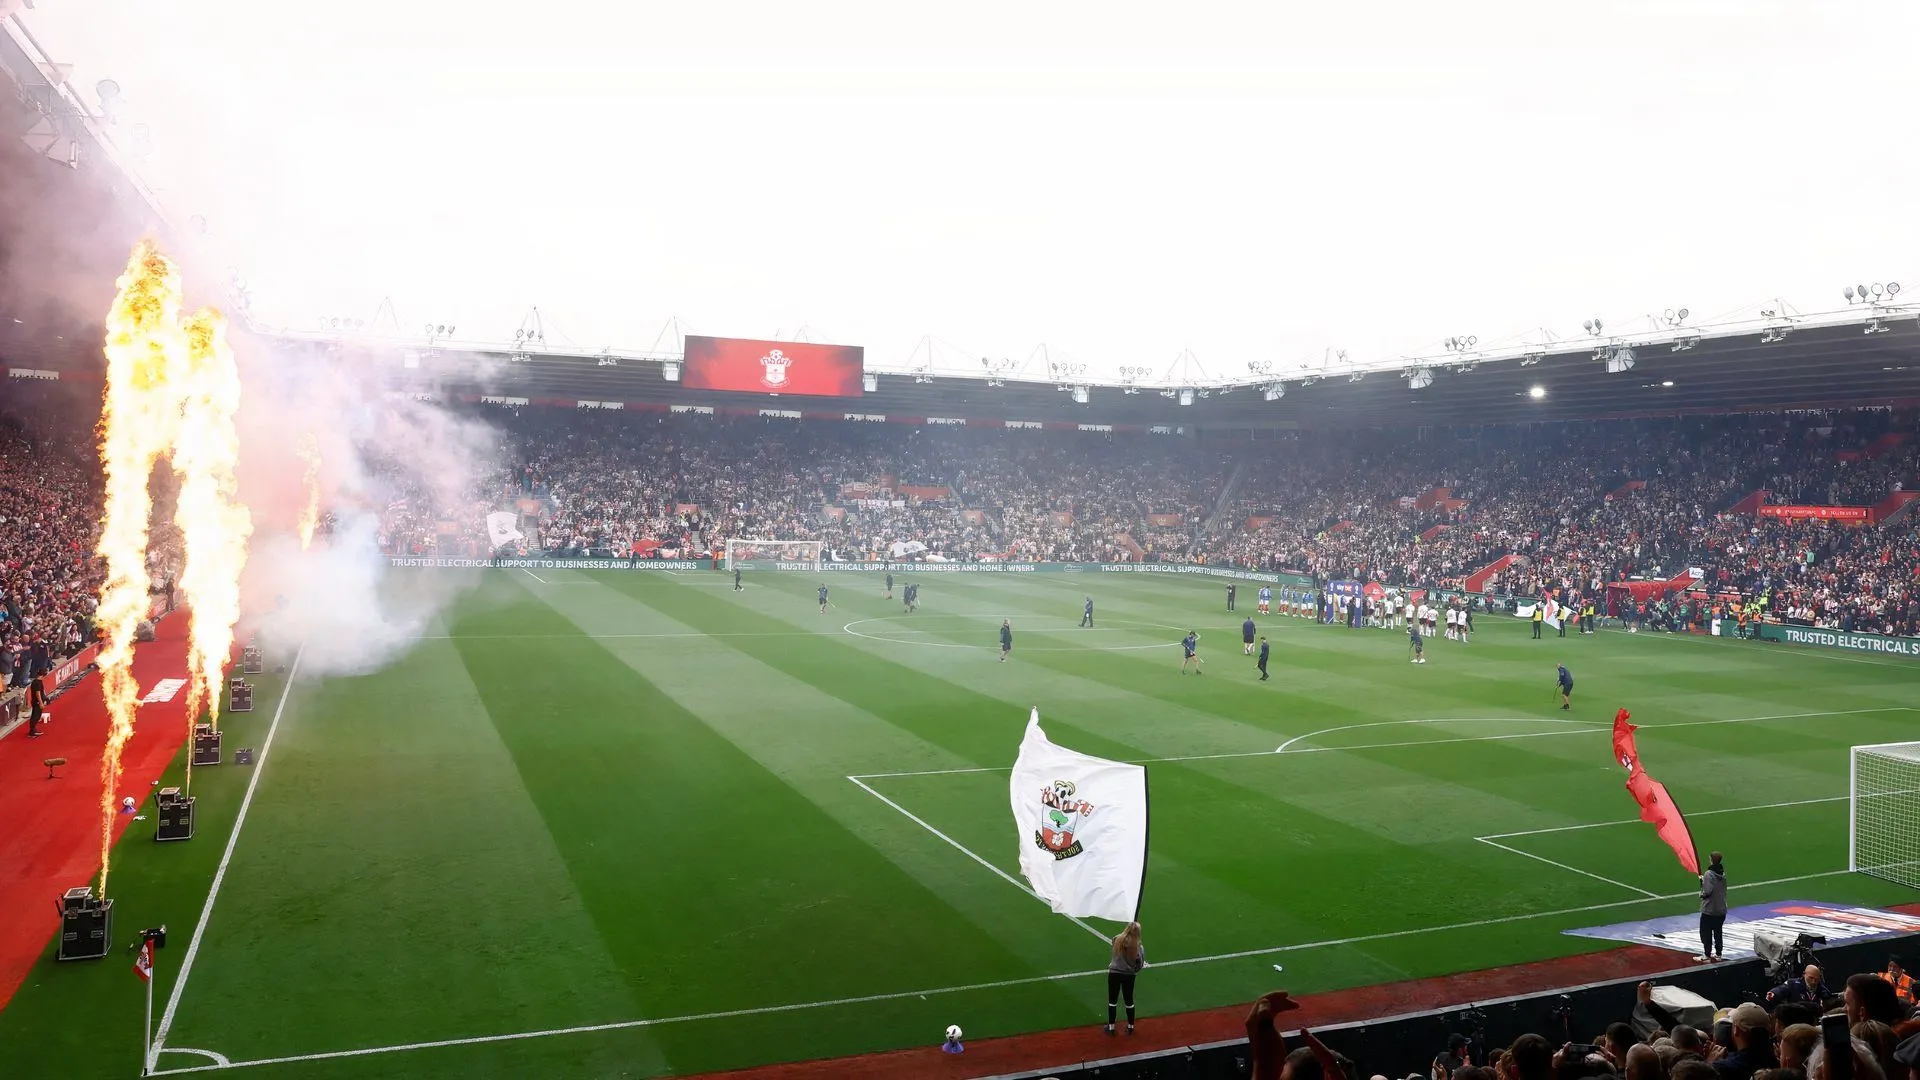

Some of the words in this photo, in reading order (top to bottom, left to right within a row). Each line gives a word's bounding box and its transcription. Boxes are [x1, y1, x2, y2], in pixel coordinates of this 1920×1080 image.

[392, 558, 434, 567] TRUSTED
[437, 559, 494, 567] ELECTRICAL
[496, 559, 538, 568] SUPPORT
[540, 560, 553, 568] TO
[555, 560, 609, 569] BUSINESSES
[610, 561, 630, 569] AND
[902, 563, 913, 572] TO
[915, 564, 960, 572] BUSINESSES
[961, 564, 978, 572] AND
[1101, 564, 1133, 572] TRUSTED
[1134, 564, 1176, 573] ELECTRICAL
[1177, 565, 1203, 575] SUPPORT
[1786, 629, 1836, 646] TRUSTED
[1838, 635, 1910, 654] ELECTRICAL
